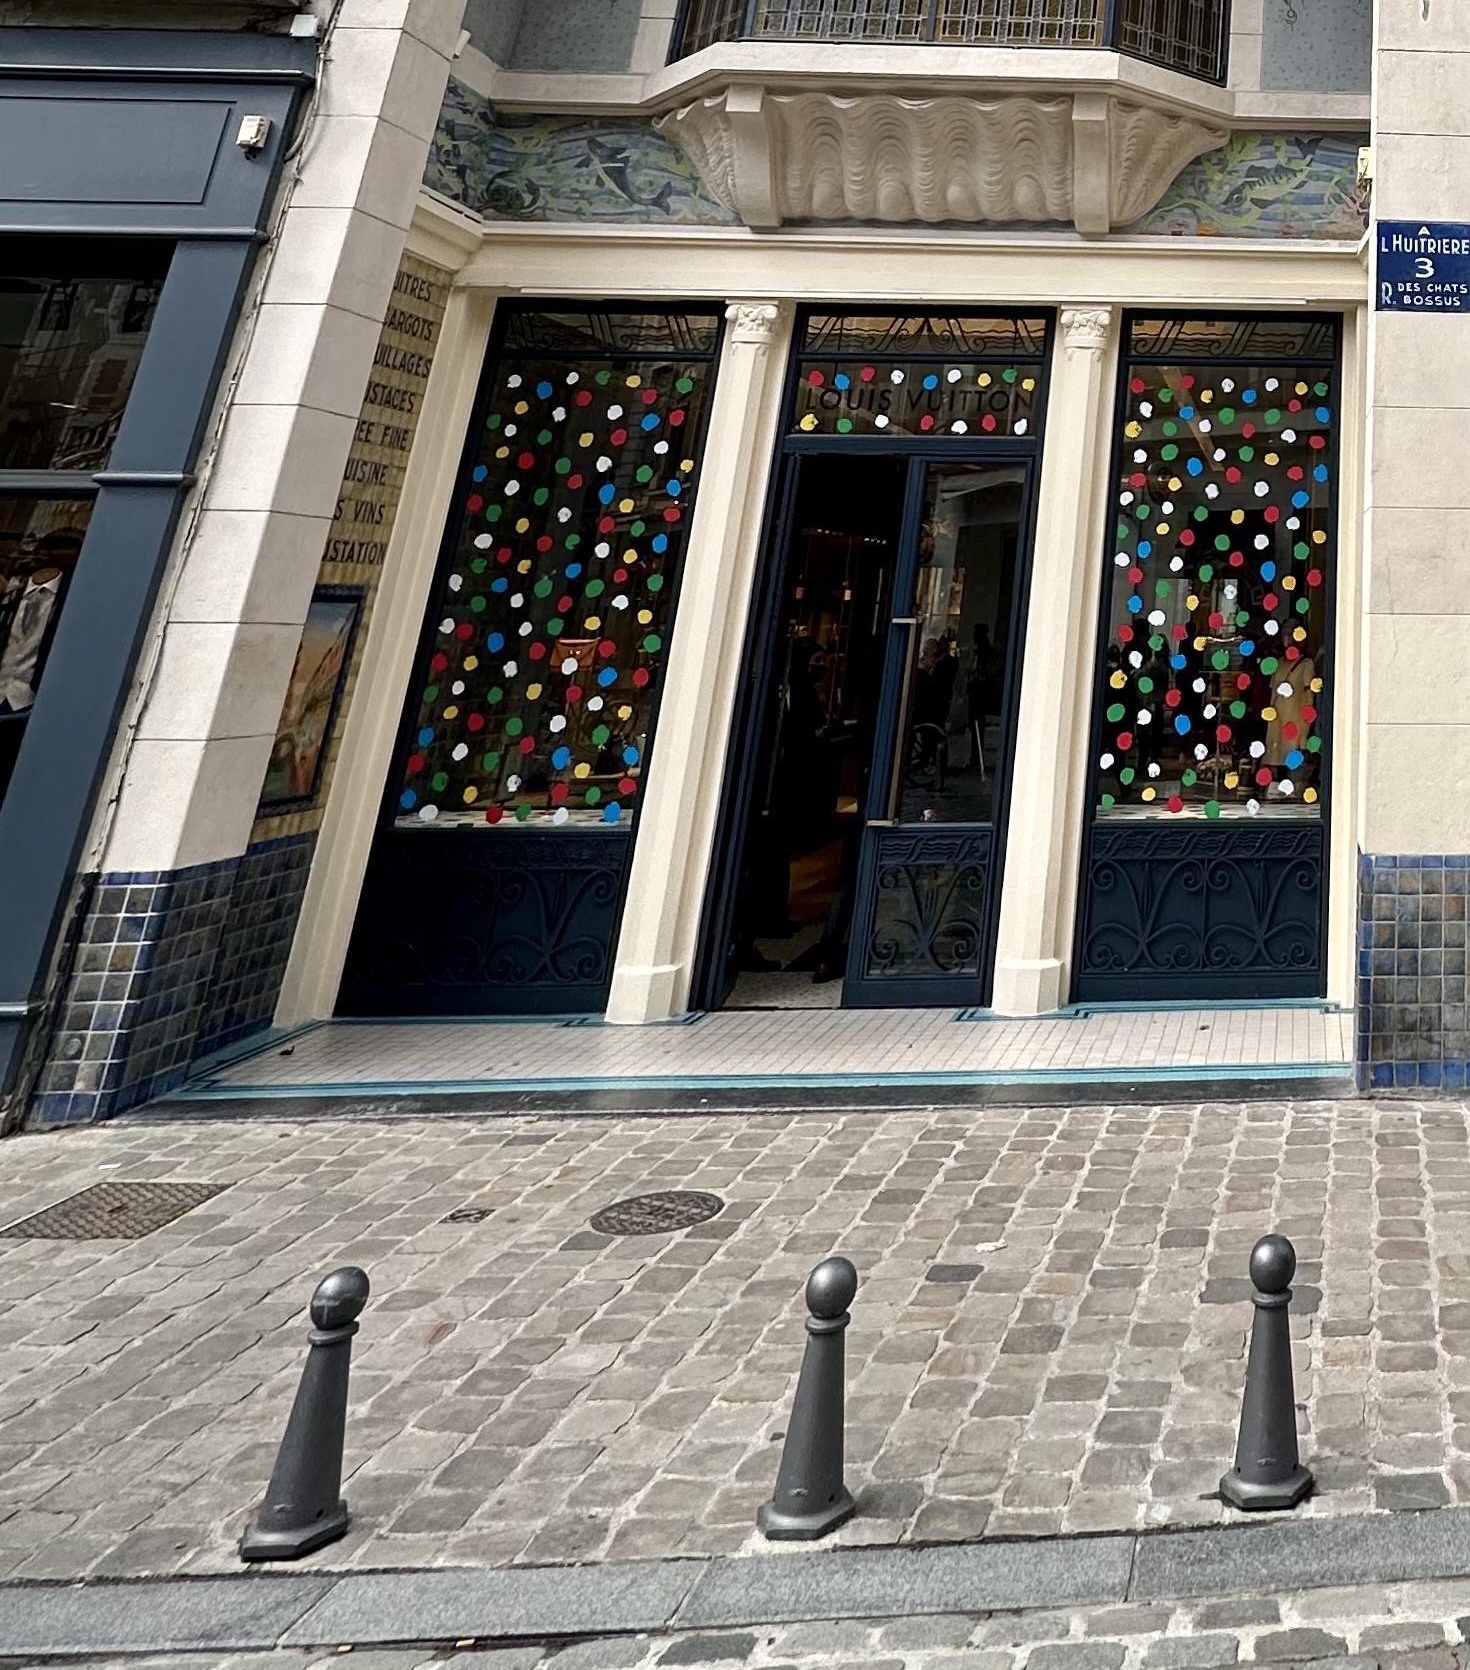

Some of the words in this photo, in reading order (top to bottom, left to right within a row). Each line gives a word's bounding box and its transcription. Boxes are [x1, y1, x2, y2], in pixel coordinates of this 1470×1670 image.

[1418, 226, 1430, 236] A
[1392, 234, 1470, 255] HUITRIERE
[1414, 257, 1435, 279] 3
[1381, 282, 1397, 305] R.
[1397, 283, 1421, 293] DES
[1427, 283, 1468, 294] CHATS
[1403, 295, 1461, 307] BOSSUS
[383, 309, 434, 341] ARGOTS
[805, 388, 893, 411] LOUIS
[906, 389, 1035, 412] VUITTON
[354, 500, 386, 525] VINS
